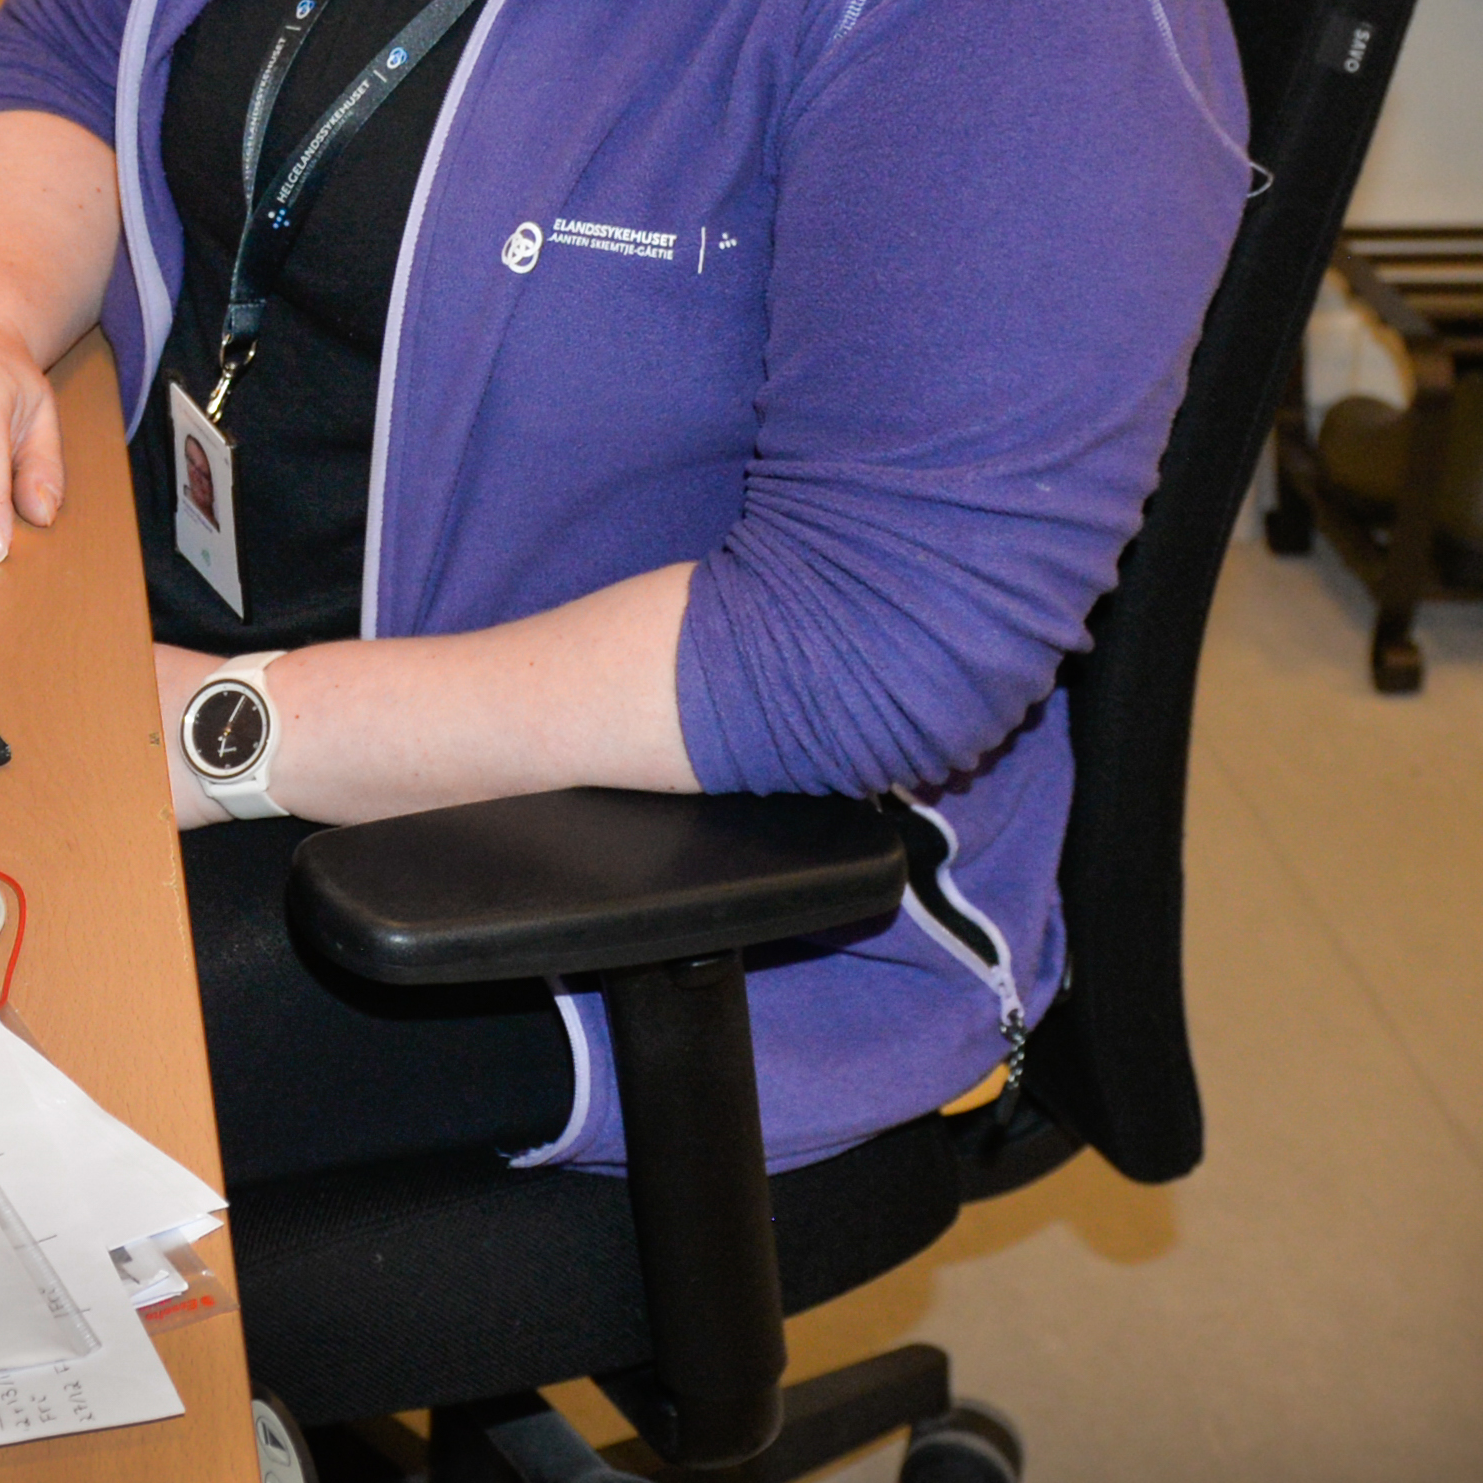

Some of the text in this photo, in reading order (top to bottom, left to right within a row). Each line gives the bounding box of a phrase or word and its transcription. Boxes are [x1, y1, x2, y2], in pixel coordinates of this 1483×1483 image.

[1344, 27, 1371, 74] SAVO
[277, 78, 371, 204] HELGELANDSSYKEHUSET
[553, 218, 678, 248] ELANDSSYKEHUSET
